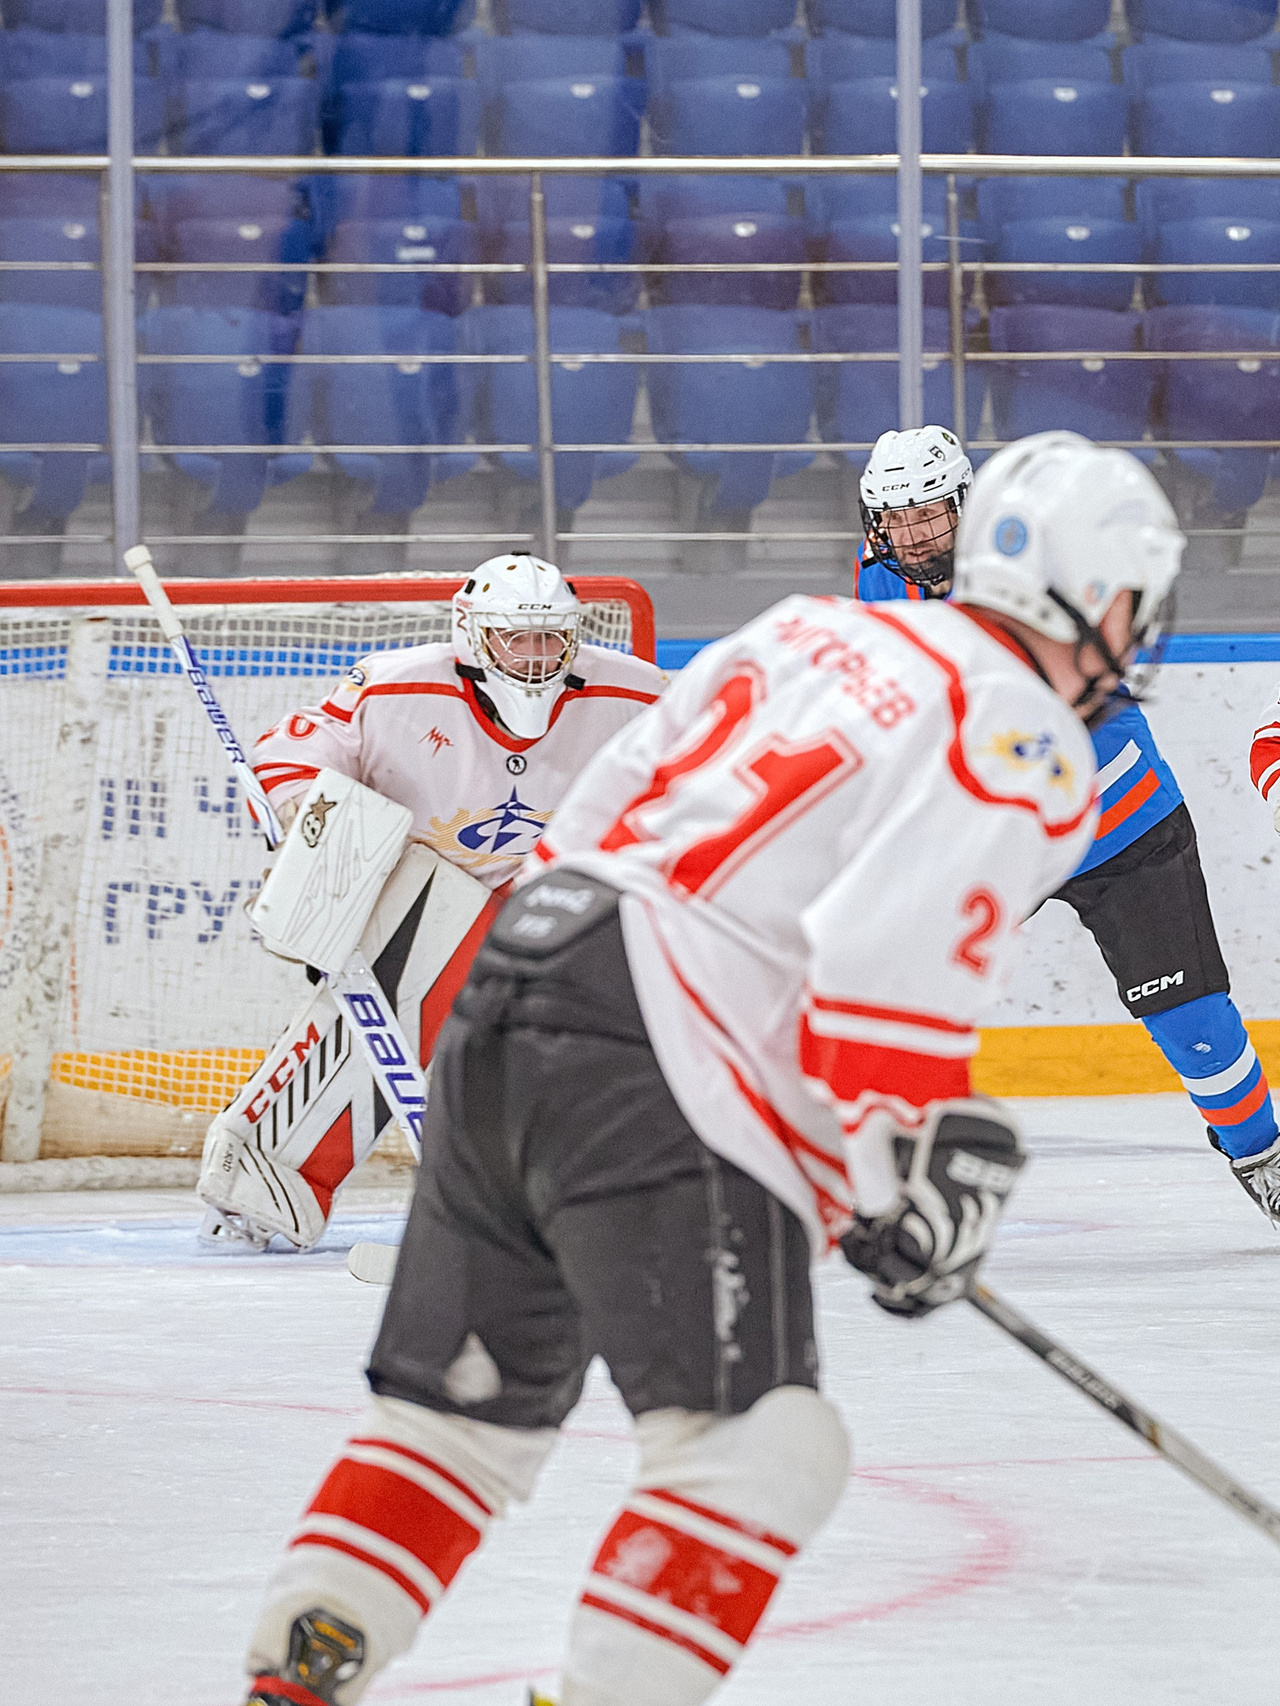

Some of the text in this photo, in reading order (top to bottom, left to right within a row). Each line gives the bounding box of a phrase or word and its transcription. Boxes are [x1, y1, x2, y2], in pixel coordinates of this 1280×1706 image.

[882, 482, 911, 492] CCM
[517, 603, 553, 611] CCM
[597, 660, 866, 902] 21
[106, 880, 263, 945] ГРУ
[953, 881, 1022, 982] 2
[1125, 970, 1184, 1002] CCM
[242, 1021, 321, 1124] CCM
